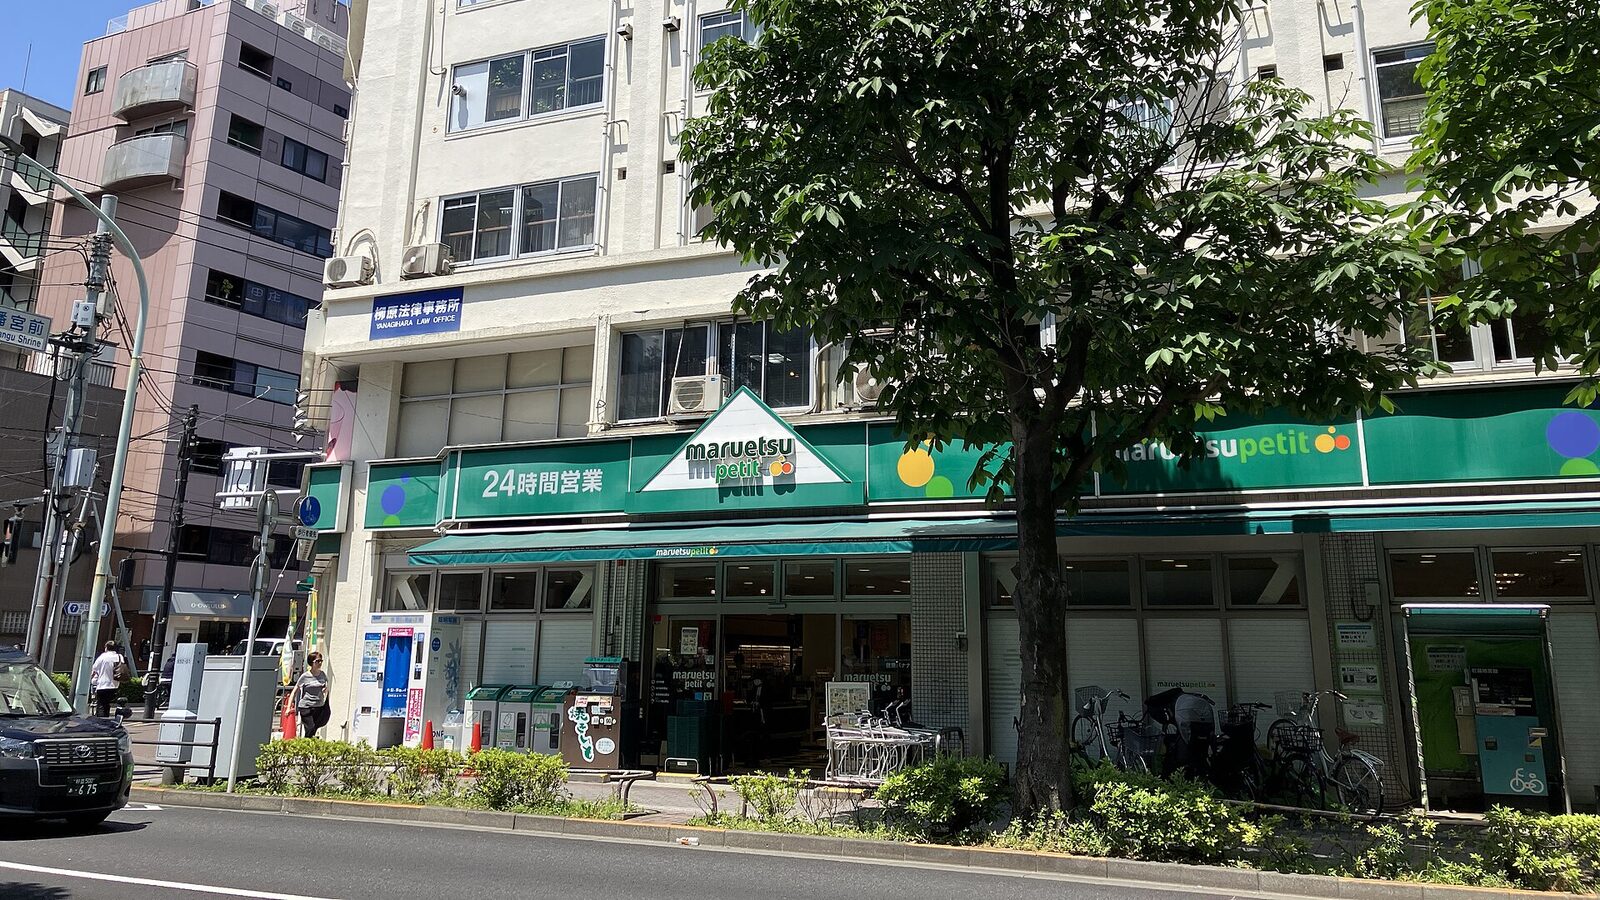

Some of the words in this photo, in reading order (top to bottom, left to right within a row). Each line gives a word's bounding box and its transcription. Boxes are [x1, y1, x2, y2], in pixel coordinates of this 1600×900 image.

[374, 299, 460, 321] 柳原法律事務所
[376, 319, 413, 330] YANAGIHARA
[416, 317, 431, 325] LAW
[433, 314, 456, 324] OFFICE
[18, 334, 42, 348] Shrine
[685, 436, 793, 461] maruetsu
[715, 459, 761, 485] petit
[482, 468, 603, 498] 24時間営業
[673, 670, 715, 680] maruetsu
[843, 673, 892, 682] maruetsu
[684, 680, 703, 690] petit
